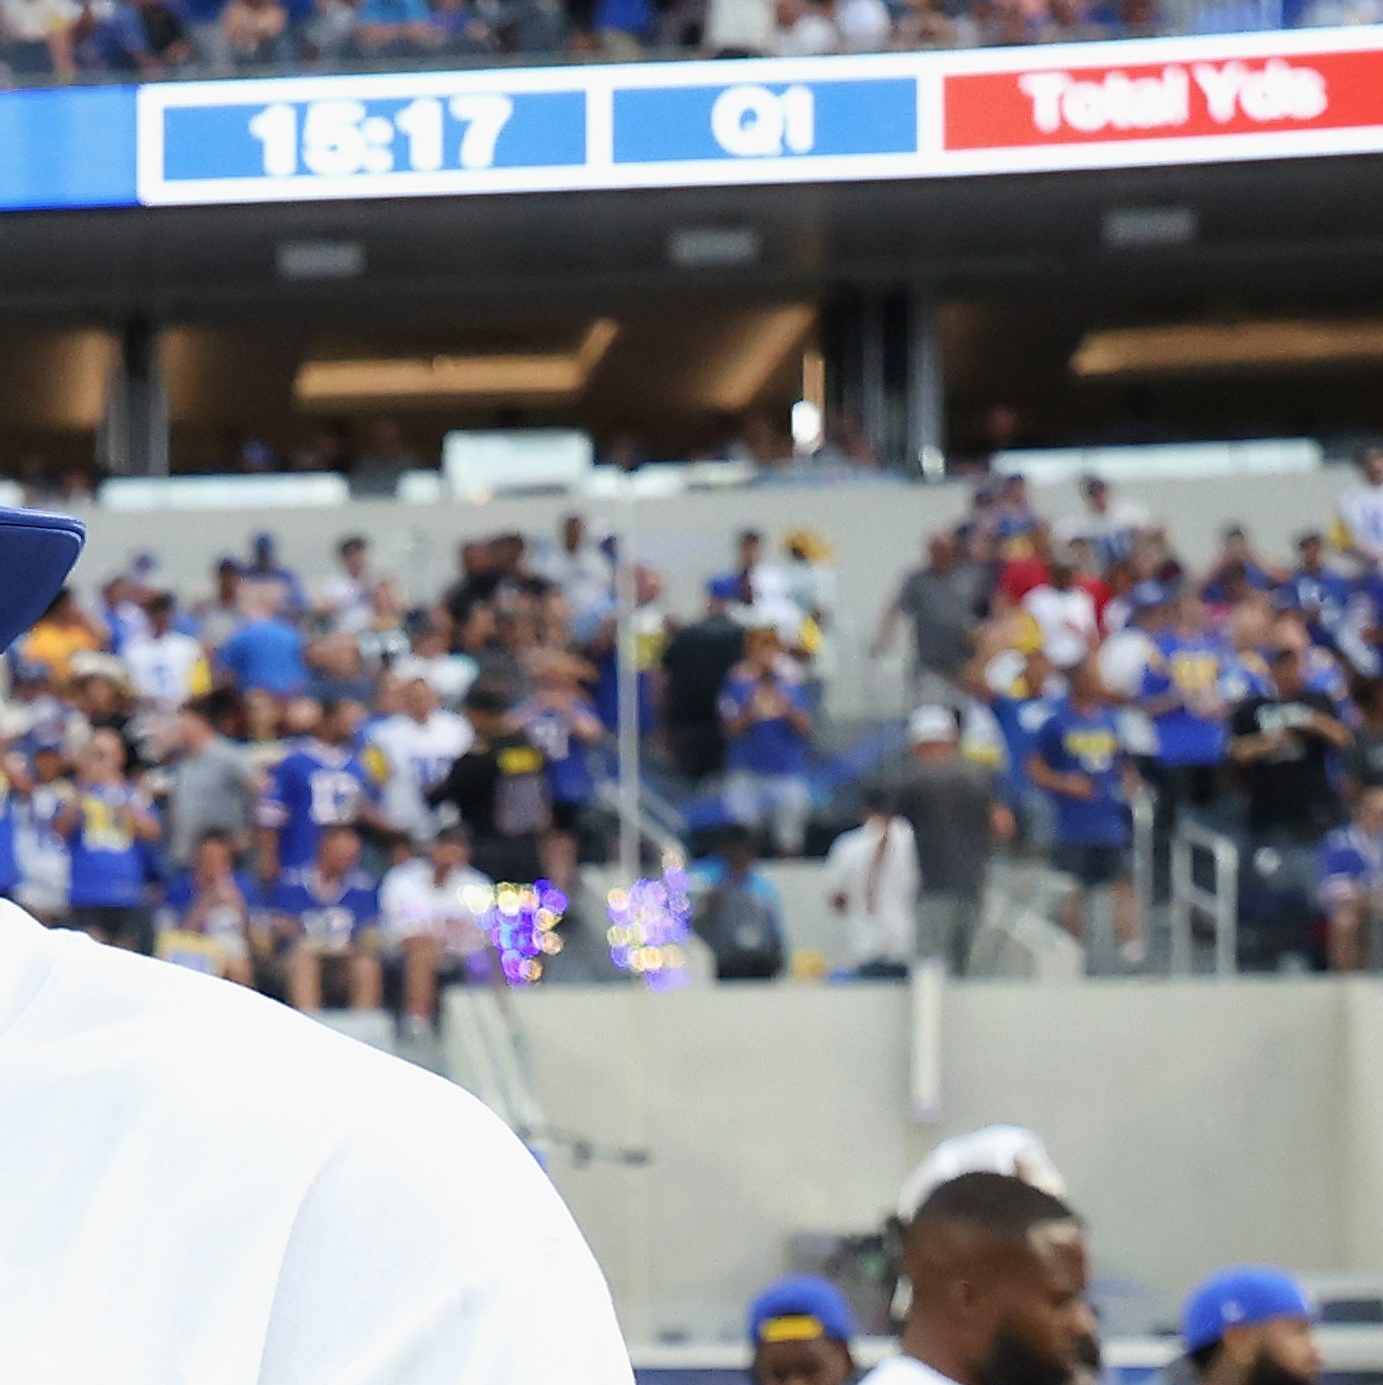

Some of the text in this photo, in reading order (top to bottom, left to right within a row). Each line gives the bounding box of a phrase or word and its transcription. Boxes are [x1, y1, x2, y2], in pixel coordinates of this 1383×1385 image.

[710, 84, 815, 157] Q1
[1017, 55, 1329, 134] Total Yds
[249, 94, 514, 176] 15:17
